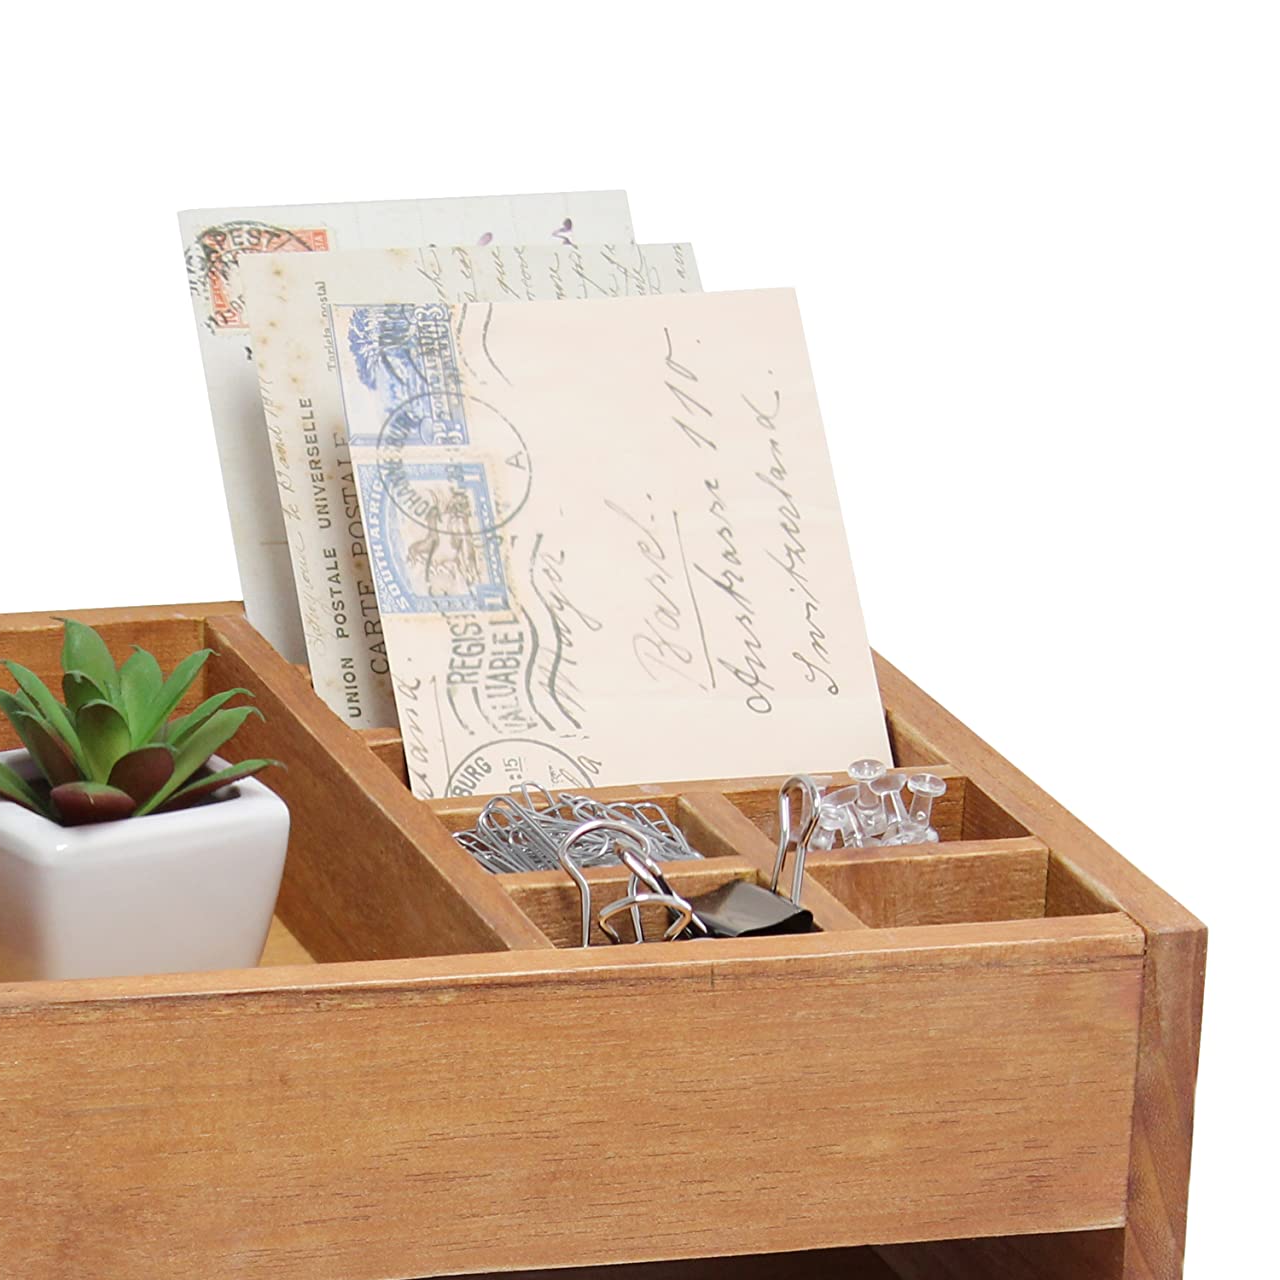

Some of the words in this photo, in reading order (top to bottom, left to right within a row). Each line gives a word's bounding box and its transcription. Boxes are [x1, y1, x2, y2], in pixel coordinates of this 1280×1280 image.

[299, 398, 332, 529] UNIVERSELLE
[323, 548, 350, 639] POSTALE
[371, 542, 411, 611] SOUTH
[340, 657, 362, 718] UNION
